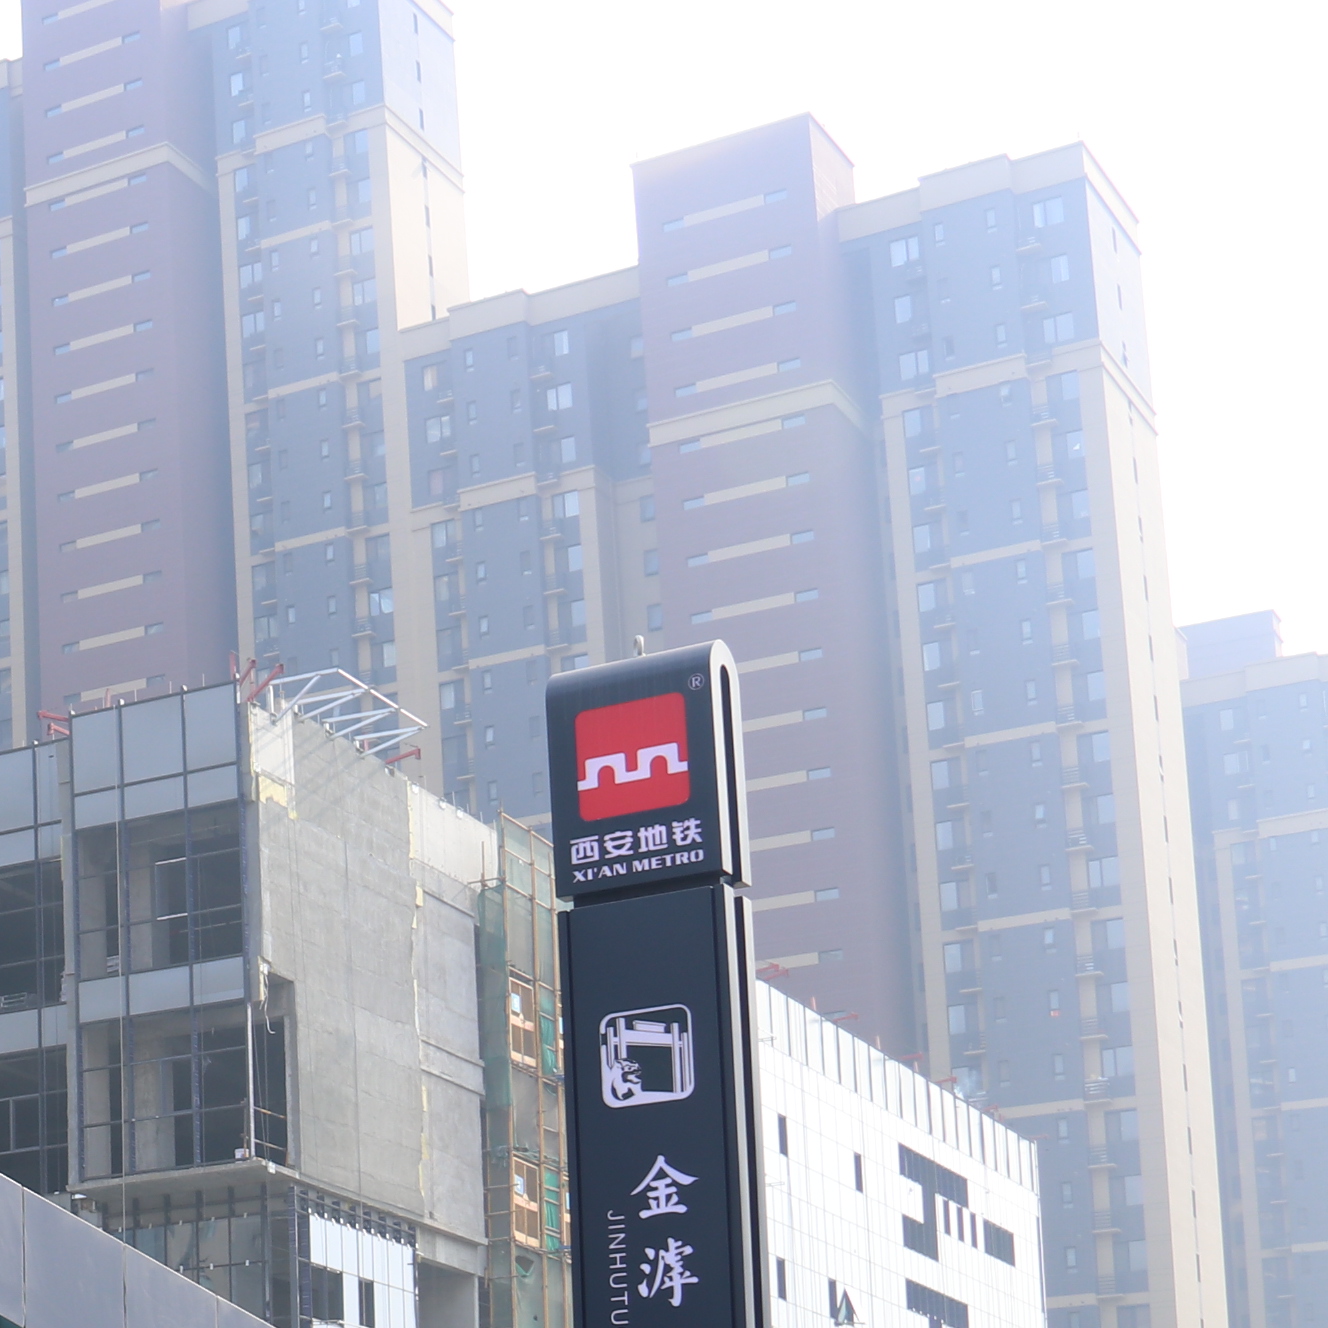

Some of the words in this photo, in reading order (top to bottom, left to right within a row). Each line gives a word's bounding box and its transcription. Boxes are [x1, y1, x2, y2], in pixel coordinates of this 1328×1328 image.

[570, 817, 704, 866] 西安地铁
[572, 862, 627, 883] XI'AN
[632, 849, 704, 873] METRO
